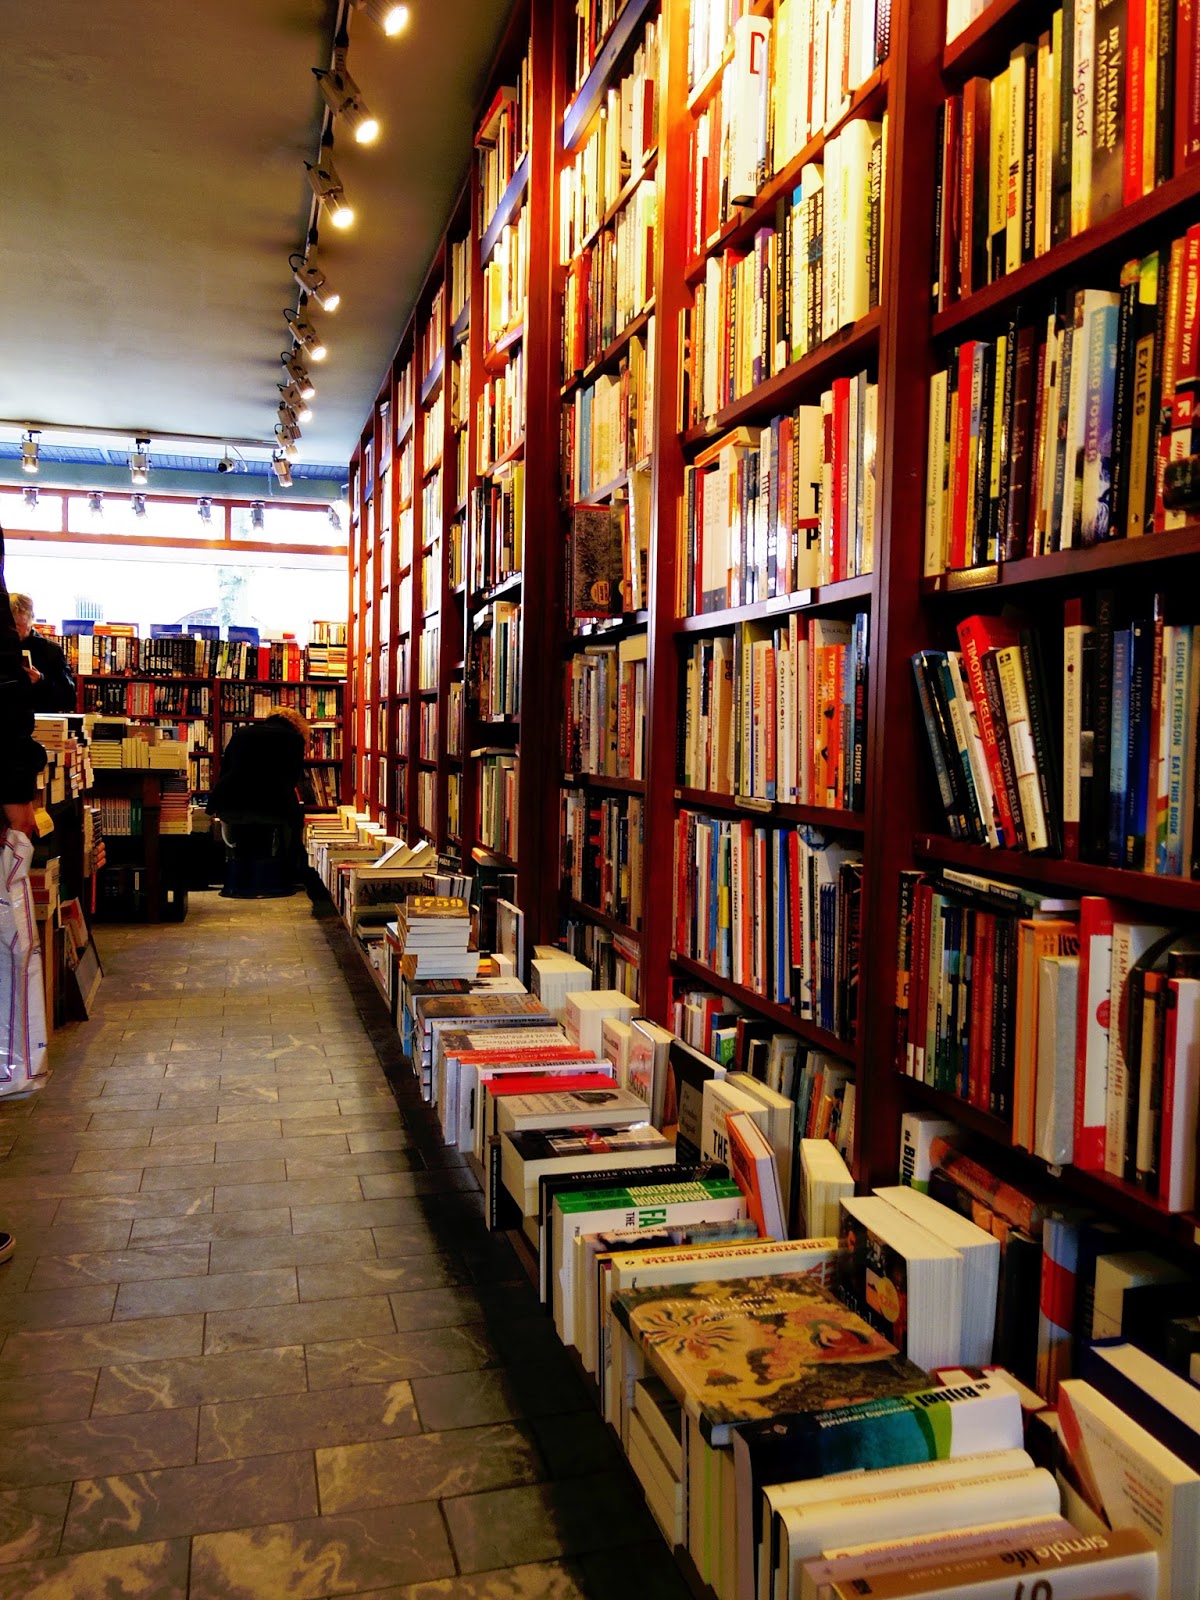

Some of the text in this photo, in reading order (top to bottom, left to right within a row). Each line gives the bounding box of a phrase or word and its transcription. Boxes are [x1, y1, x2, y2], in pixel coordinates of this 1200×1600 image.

[1109, 26, 1120, 53] DE
[1073, 83, 1088, 137] geloof
[1096, 40, 1108, 148] DAGBOEKEN
[1181, 333, 1191, 365] WAYS
[1087, 314, 1104, 462] RICHARD FOSTER
[1136, 348, 1148, 416] EXILES
[971, 383, 980, 423] DEEPER
[827, 678, 835, 701] DOG
[966, 639, 985, 696] TIMOTHY
[979, 698, 995, 748] KELLER
[1006, 667, 1021, 714] TIMOTHY
[1170, 642, 1186, 835] EUGENE PETERSON EAT THIS BOOK
[854, 744, 862, 784] CHOICE
[998, 739, 1021, 825] TIMOTHY KELLER
[414, 897, 463, 907] 1759
[1120, 938, 1129, 975] ISLAM
[902, 1129, 915, 1187] de Bijbe
[626, 1181, 705, 1197] FARMAGEDDON
[631, 1190, 712, 1206] FARMAGEDDON
[626, 1212, 635, 1227] THE
[914, 1383, 991, 1407] de Bijbel
[1001, 1546, 1038, 1568] life
[1035, 1534, 1110, 1560] simple
